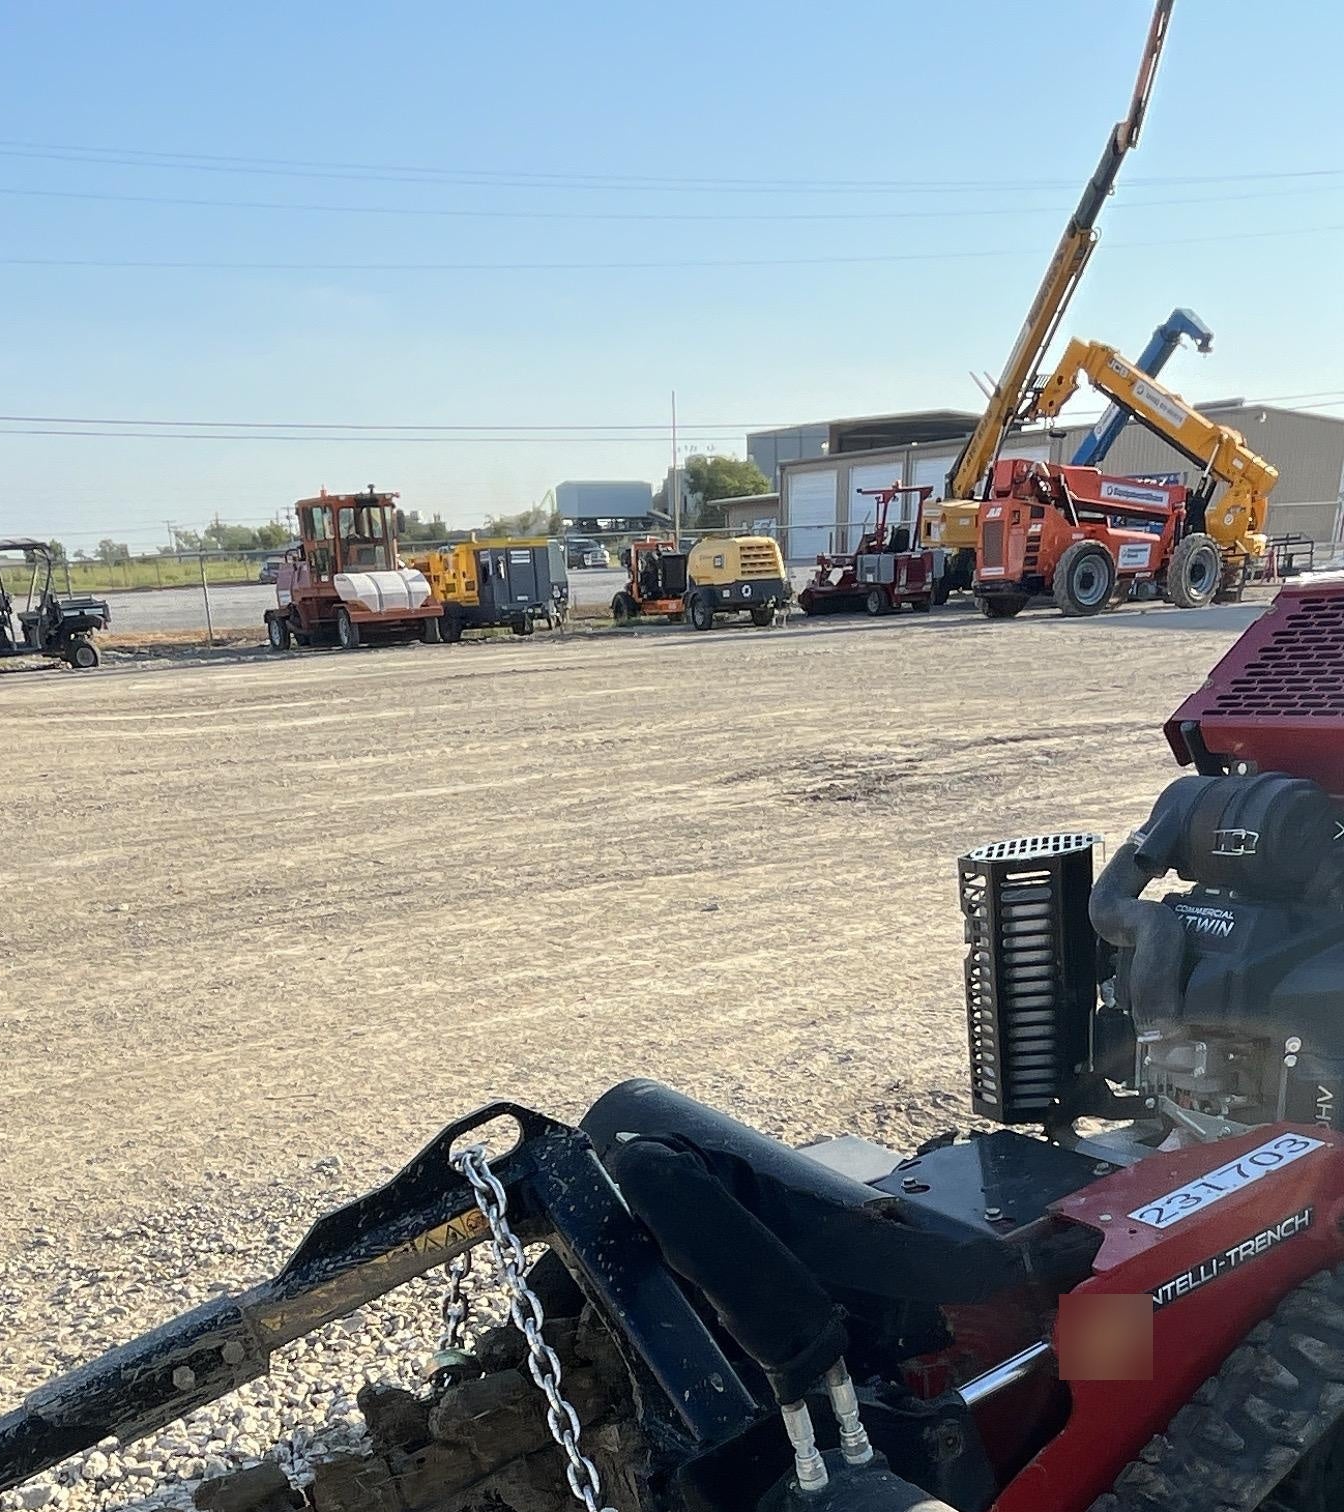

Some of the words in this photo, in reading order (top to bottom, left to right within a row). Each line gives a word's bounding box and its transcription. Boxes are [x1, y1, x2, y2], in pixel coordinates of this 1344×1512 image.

[1174, 904, 1234, 920] COMMERCIAL
[1138, 1137, 1311, 1225] 231703
[1152, 1209, 1310, 1305] NTELLI-TRENCH
